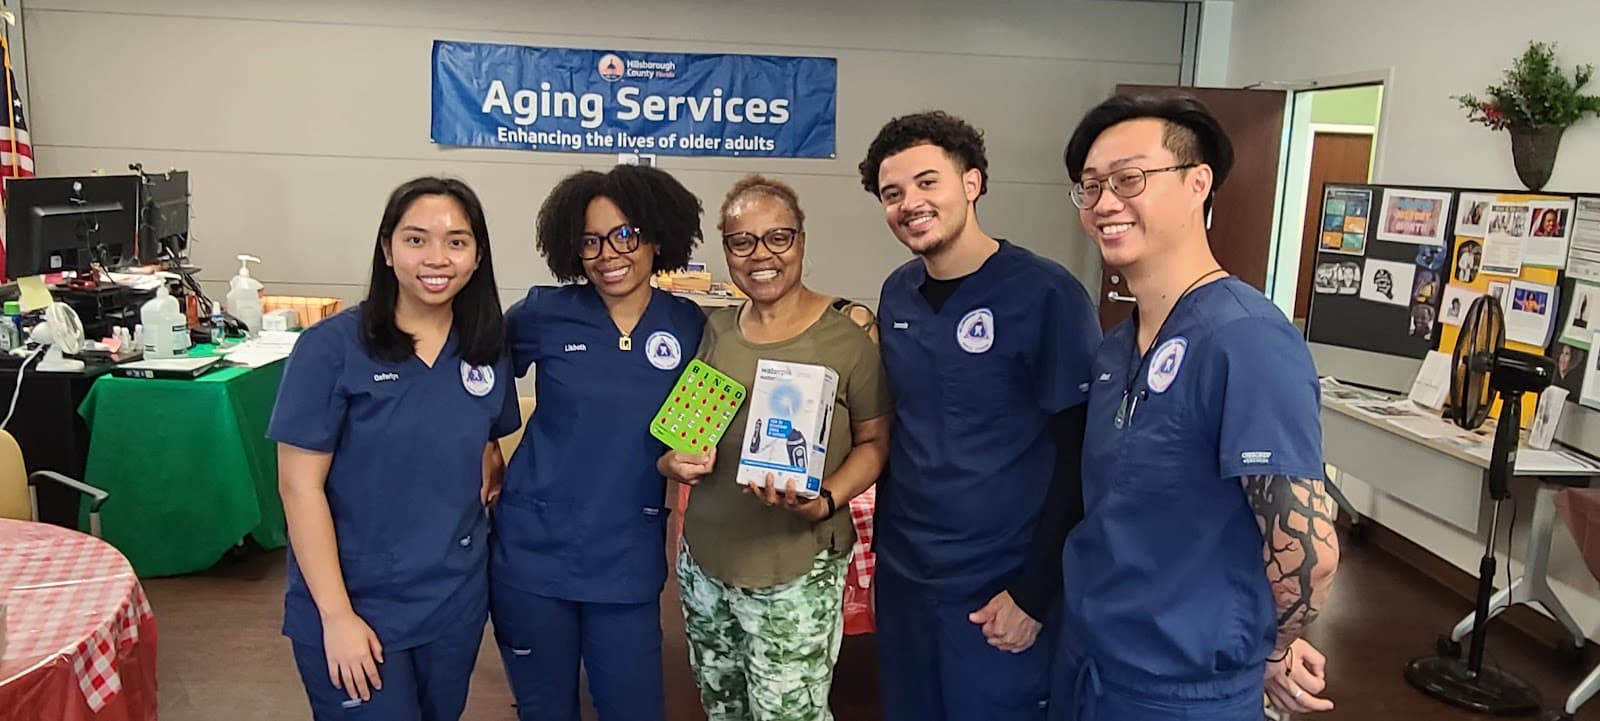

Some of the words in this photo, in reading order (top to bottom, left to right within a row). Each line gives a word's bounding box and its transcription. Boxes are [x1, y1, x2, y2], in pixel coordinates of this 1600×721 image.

[626, 59, 676, 72] Hillsborough
[626, 68, 655, 79] County
[482, 80, 604, 128] Aging
[616, 86, 790, 124] Services
[497, 127, 582, 149] Enhancing
[585, 132, 613, 147] the
[617, 132, 655, 148] lives
[658, 133, 677, 148] of
[679, 134, 721, 150] older
[724, 135, 775, 151] adults
[691, 365, 743, 400] BINGO
